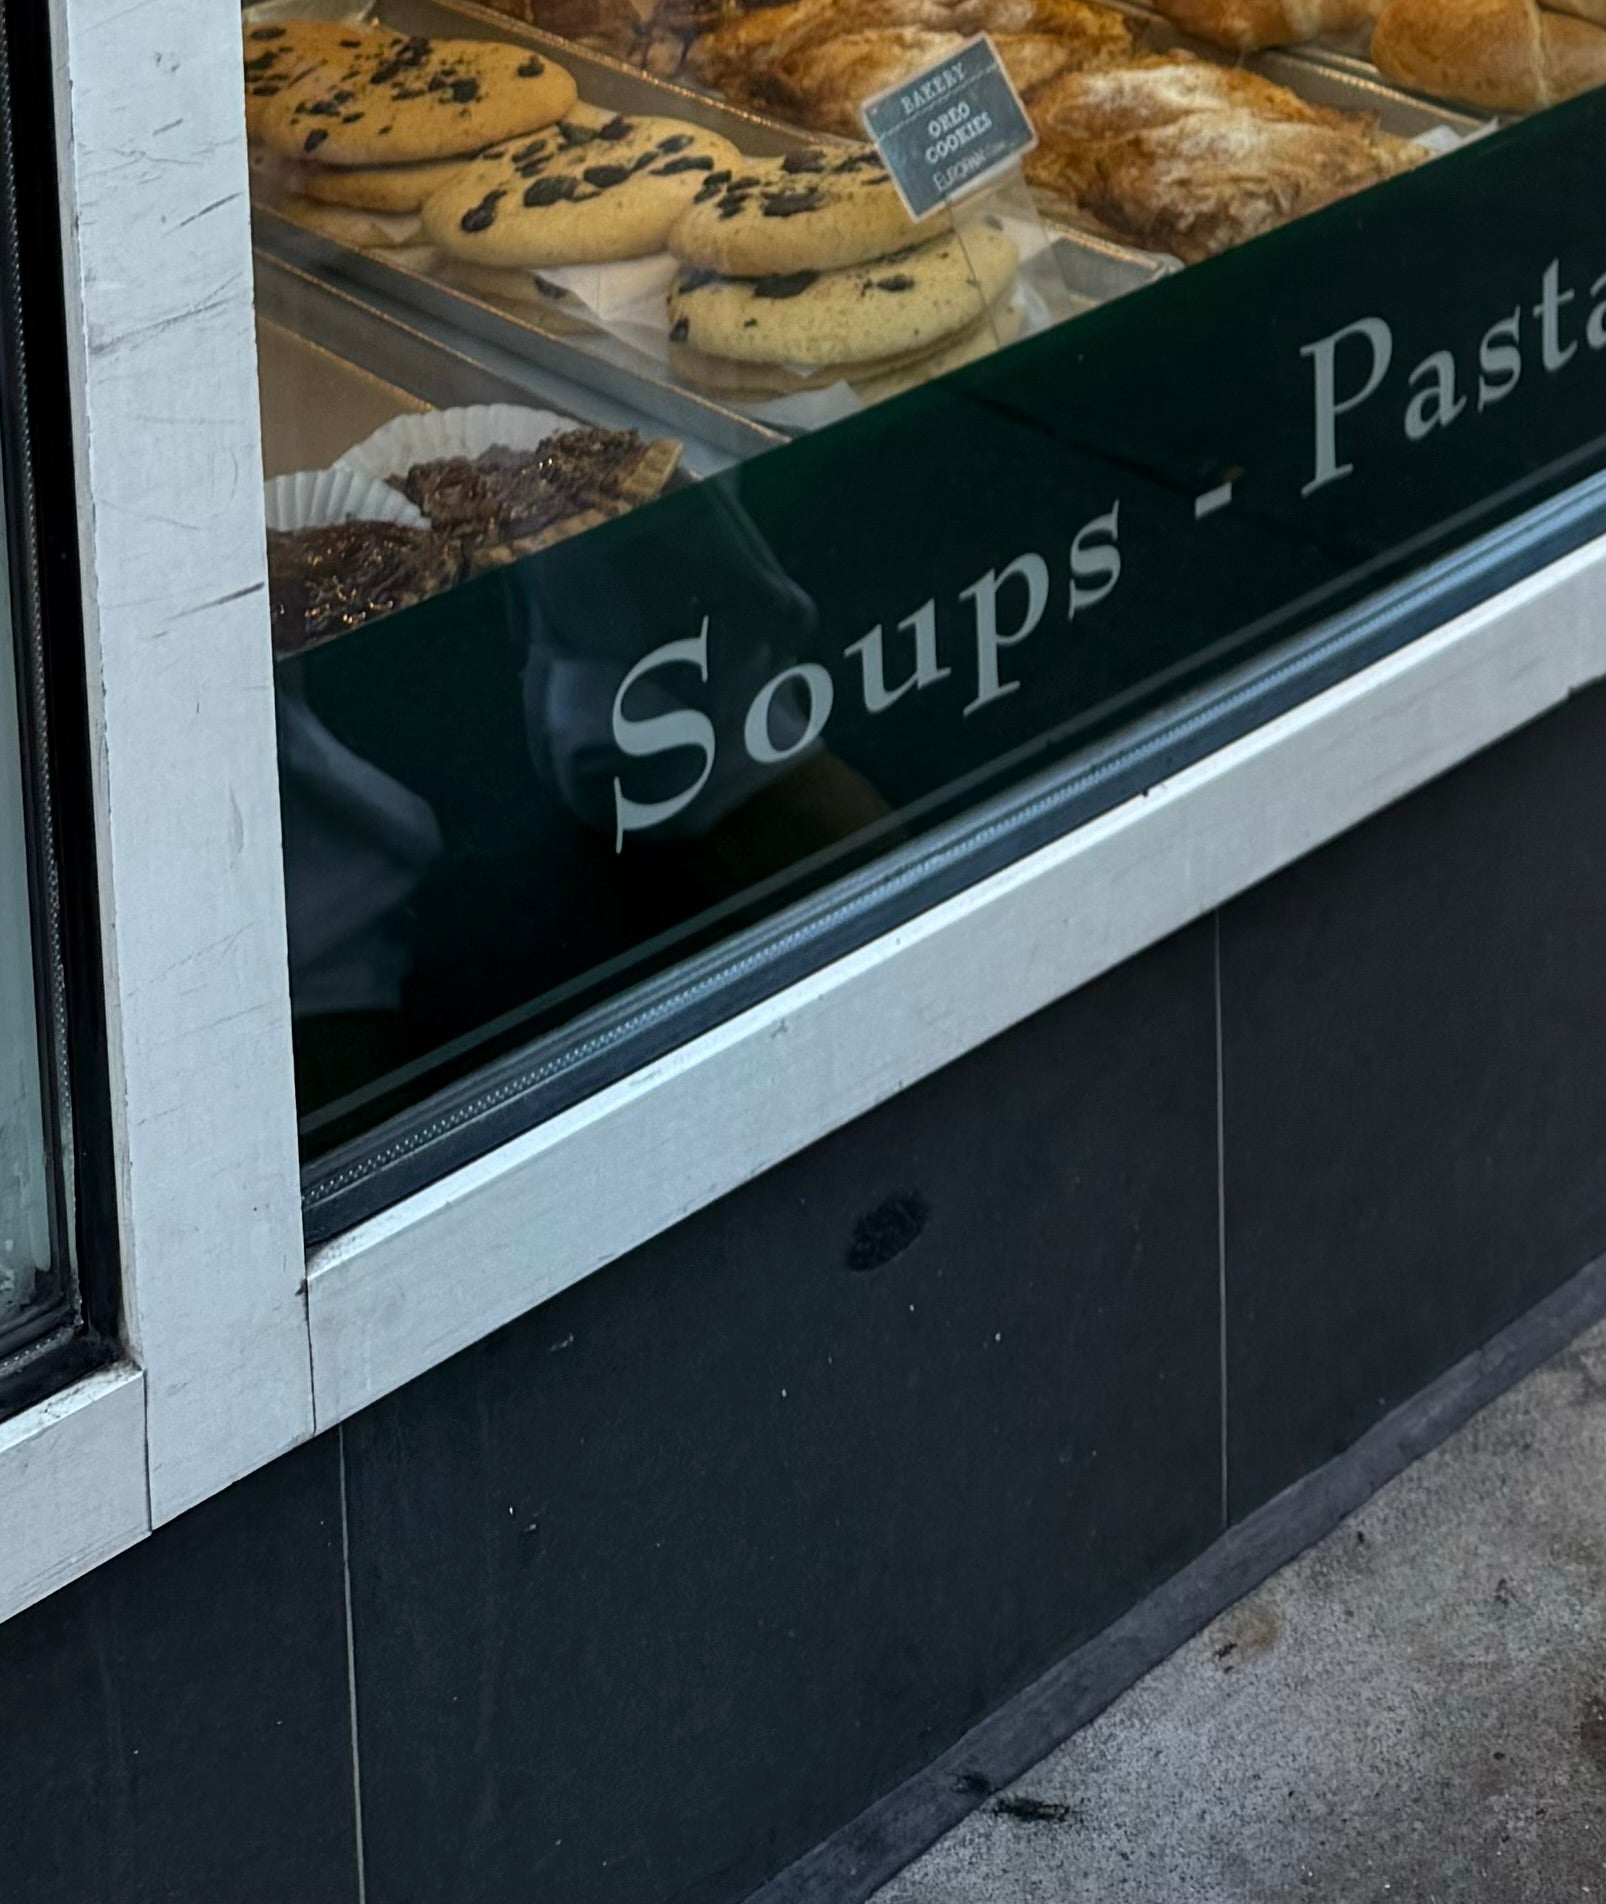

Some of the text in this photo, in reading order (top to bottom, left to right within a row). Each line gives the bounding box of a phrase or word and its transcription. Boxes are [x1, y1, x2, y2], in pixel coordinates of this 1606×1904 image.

[901, 62, 966, 114] BAKERY
[925, 111, 992, 164] COOKIES
[927, 101, 970, 139] OREO
[611, 499, 1120, 854] Soups
